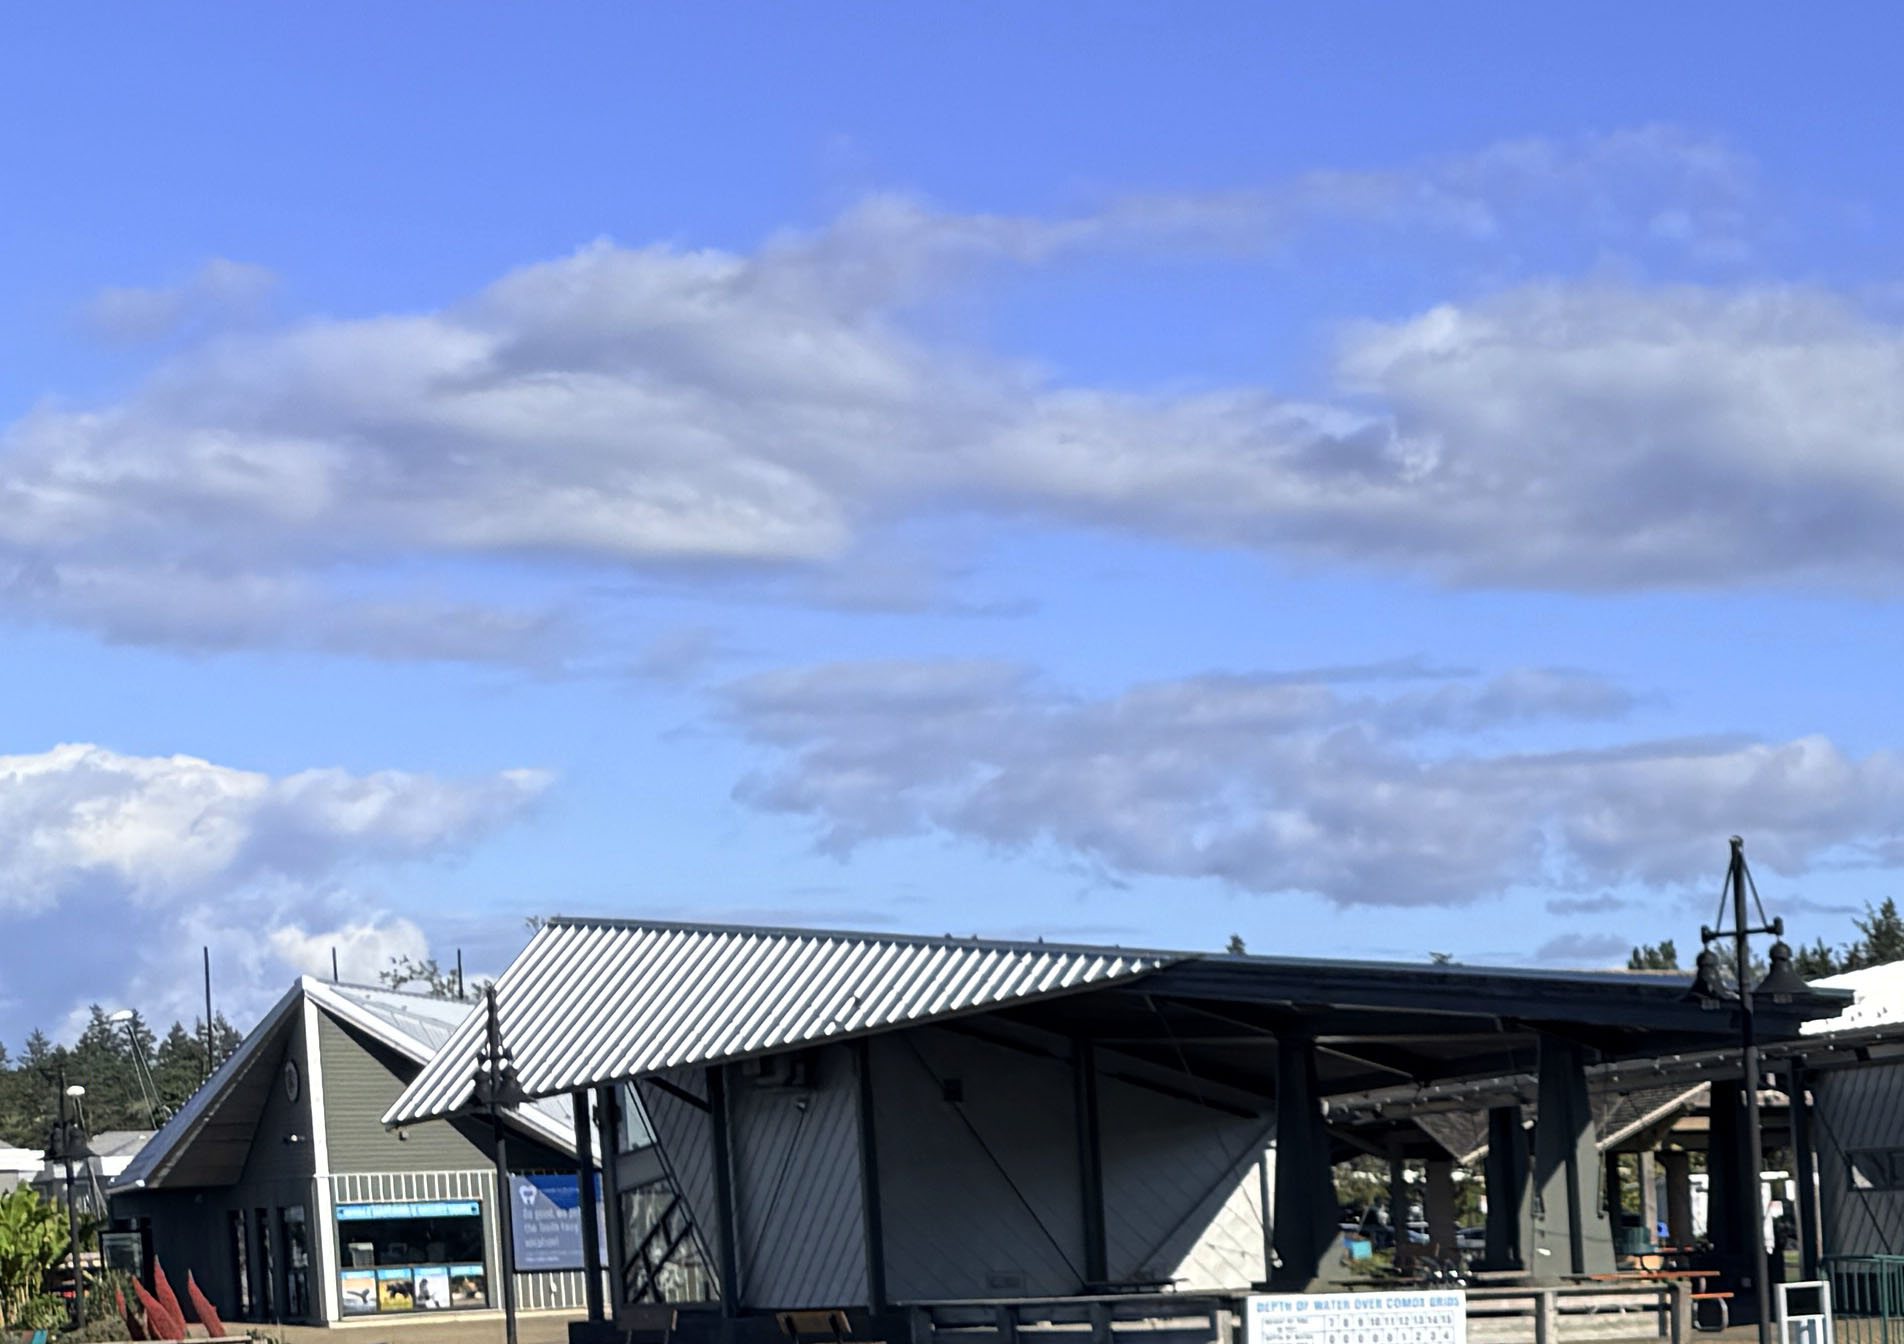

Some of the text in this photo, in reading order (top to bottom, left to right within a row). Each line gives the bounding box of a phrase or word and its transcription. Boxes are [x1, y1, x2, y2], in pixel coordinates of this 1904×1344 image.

[1256, 1296, 1460, 1313] DEPTH OF WATER OVER COMOX GRIDS
[1370, 1317, 1380, 1326] 10
[1384, 1317, 1394, 1326] 11
[1399, 1316, 1409, 1325] 12
